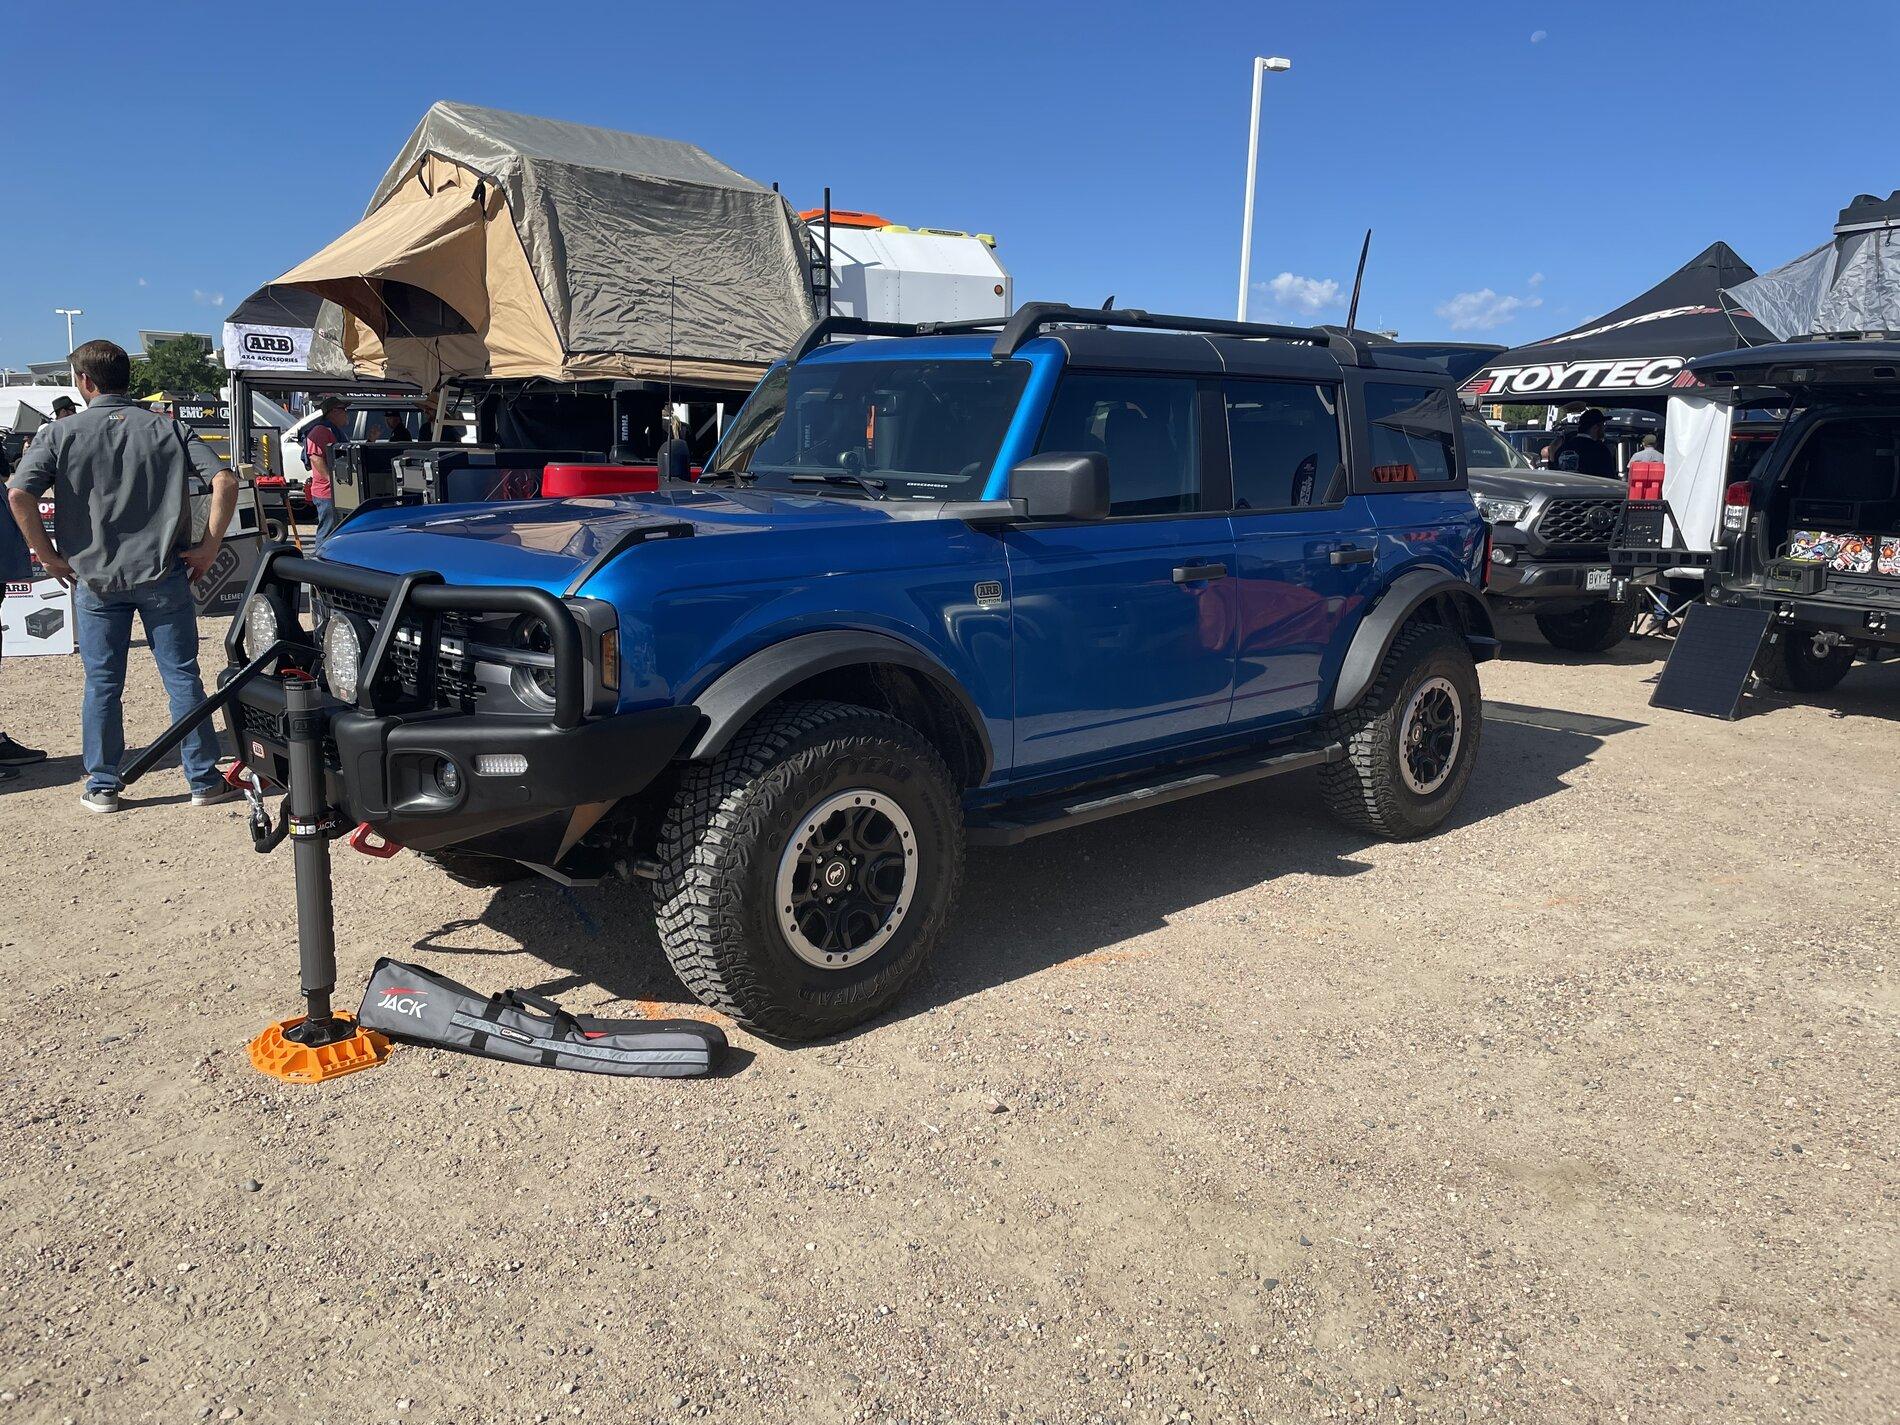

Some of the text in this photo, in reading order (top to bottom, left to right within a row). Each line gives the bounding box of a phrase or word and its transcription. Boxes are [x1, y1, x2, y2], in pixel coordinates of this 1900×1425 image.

[249, 336, 290, 352] ARB
[257, 355, 299, 363] ACCESSORIES
[1487, 359, 1684, 395] TOYTEC
[179, 410, 204, 419] EMU
[621, 414, 629, 441] THULE
[5, 584, 29, 592] ARB
[979, 585, 1000, 596] ARB
[377, 994, 428, 1019] JACK
